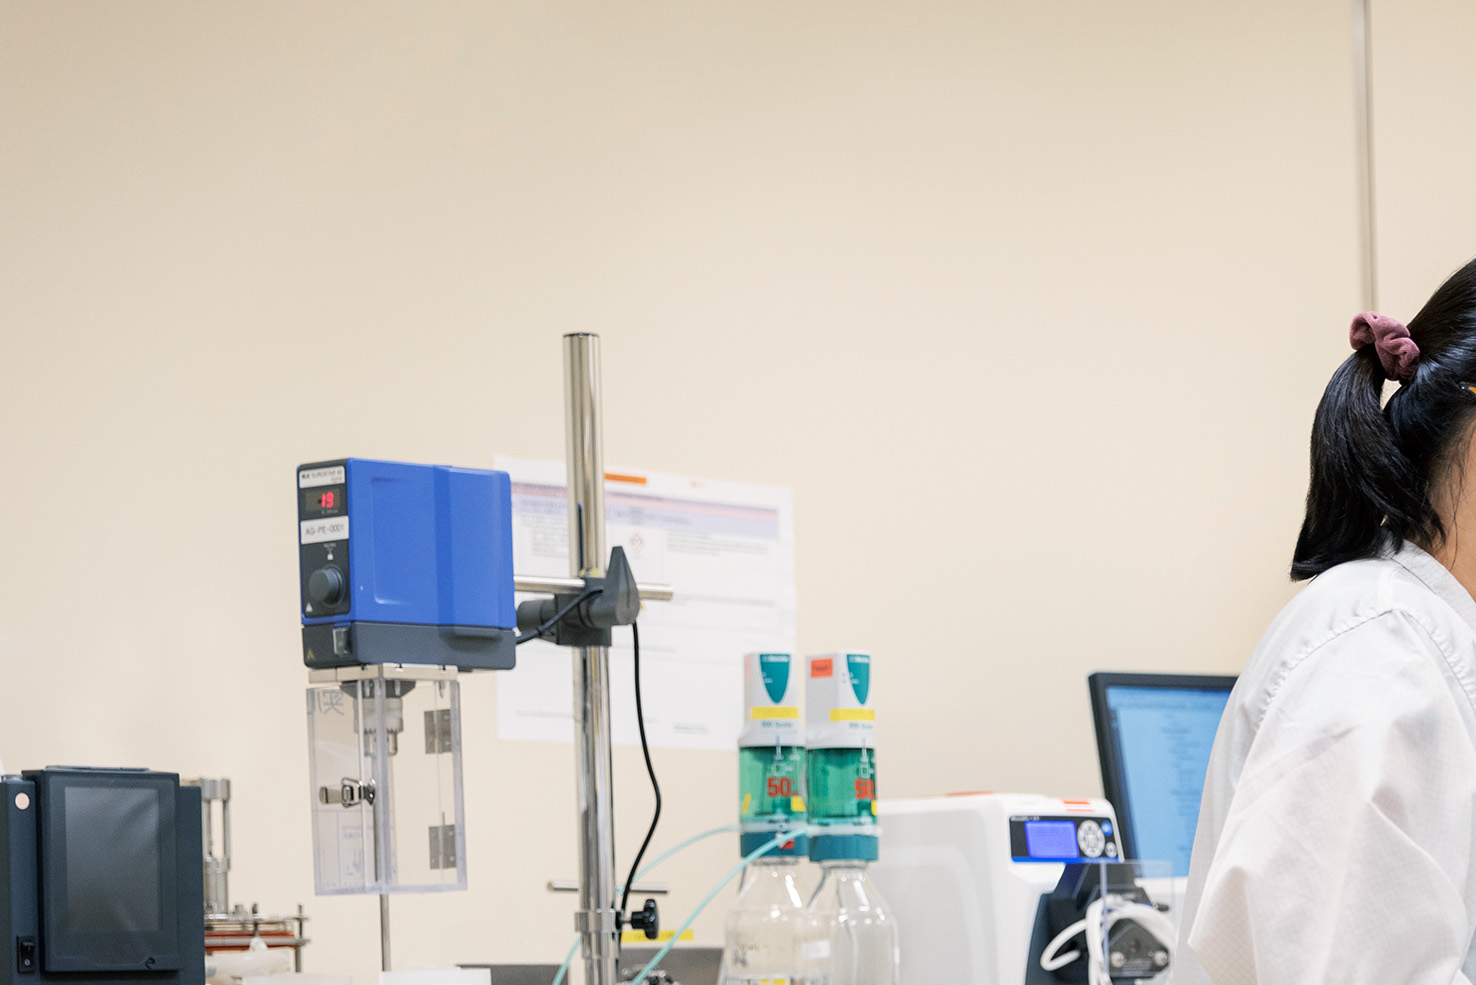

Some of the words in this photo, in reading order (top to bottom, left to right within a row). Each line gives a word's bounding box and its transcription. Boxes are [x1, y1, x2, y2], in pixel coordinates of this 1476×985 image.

[321, 492, 334, 508] 19
[767, 776, 791, 798] 50
[854, 777, 874, 800] 50
